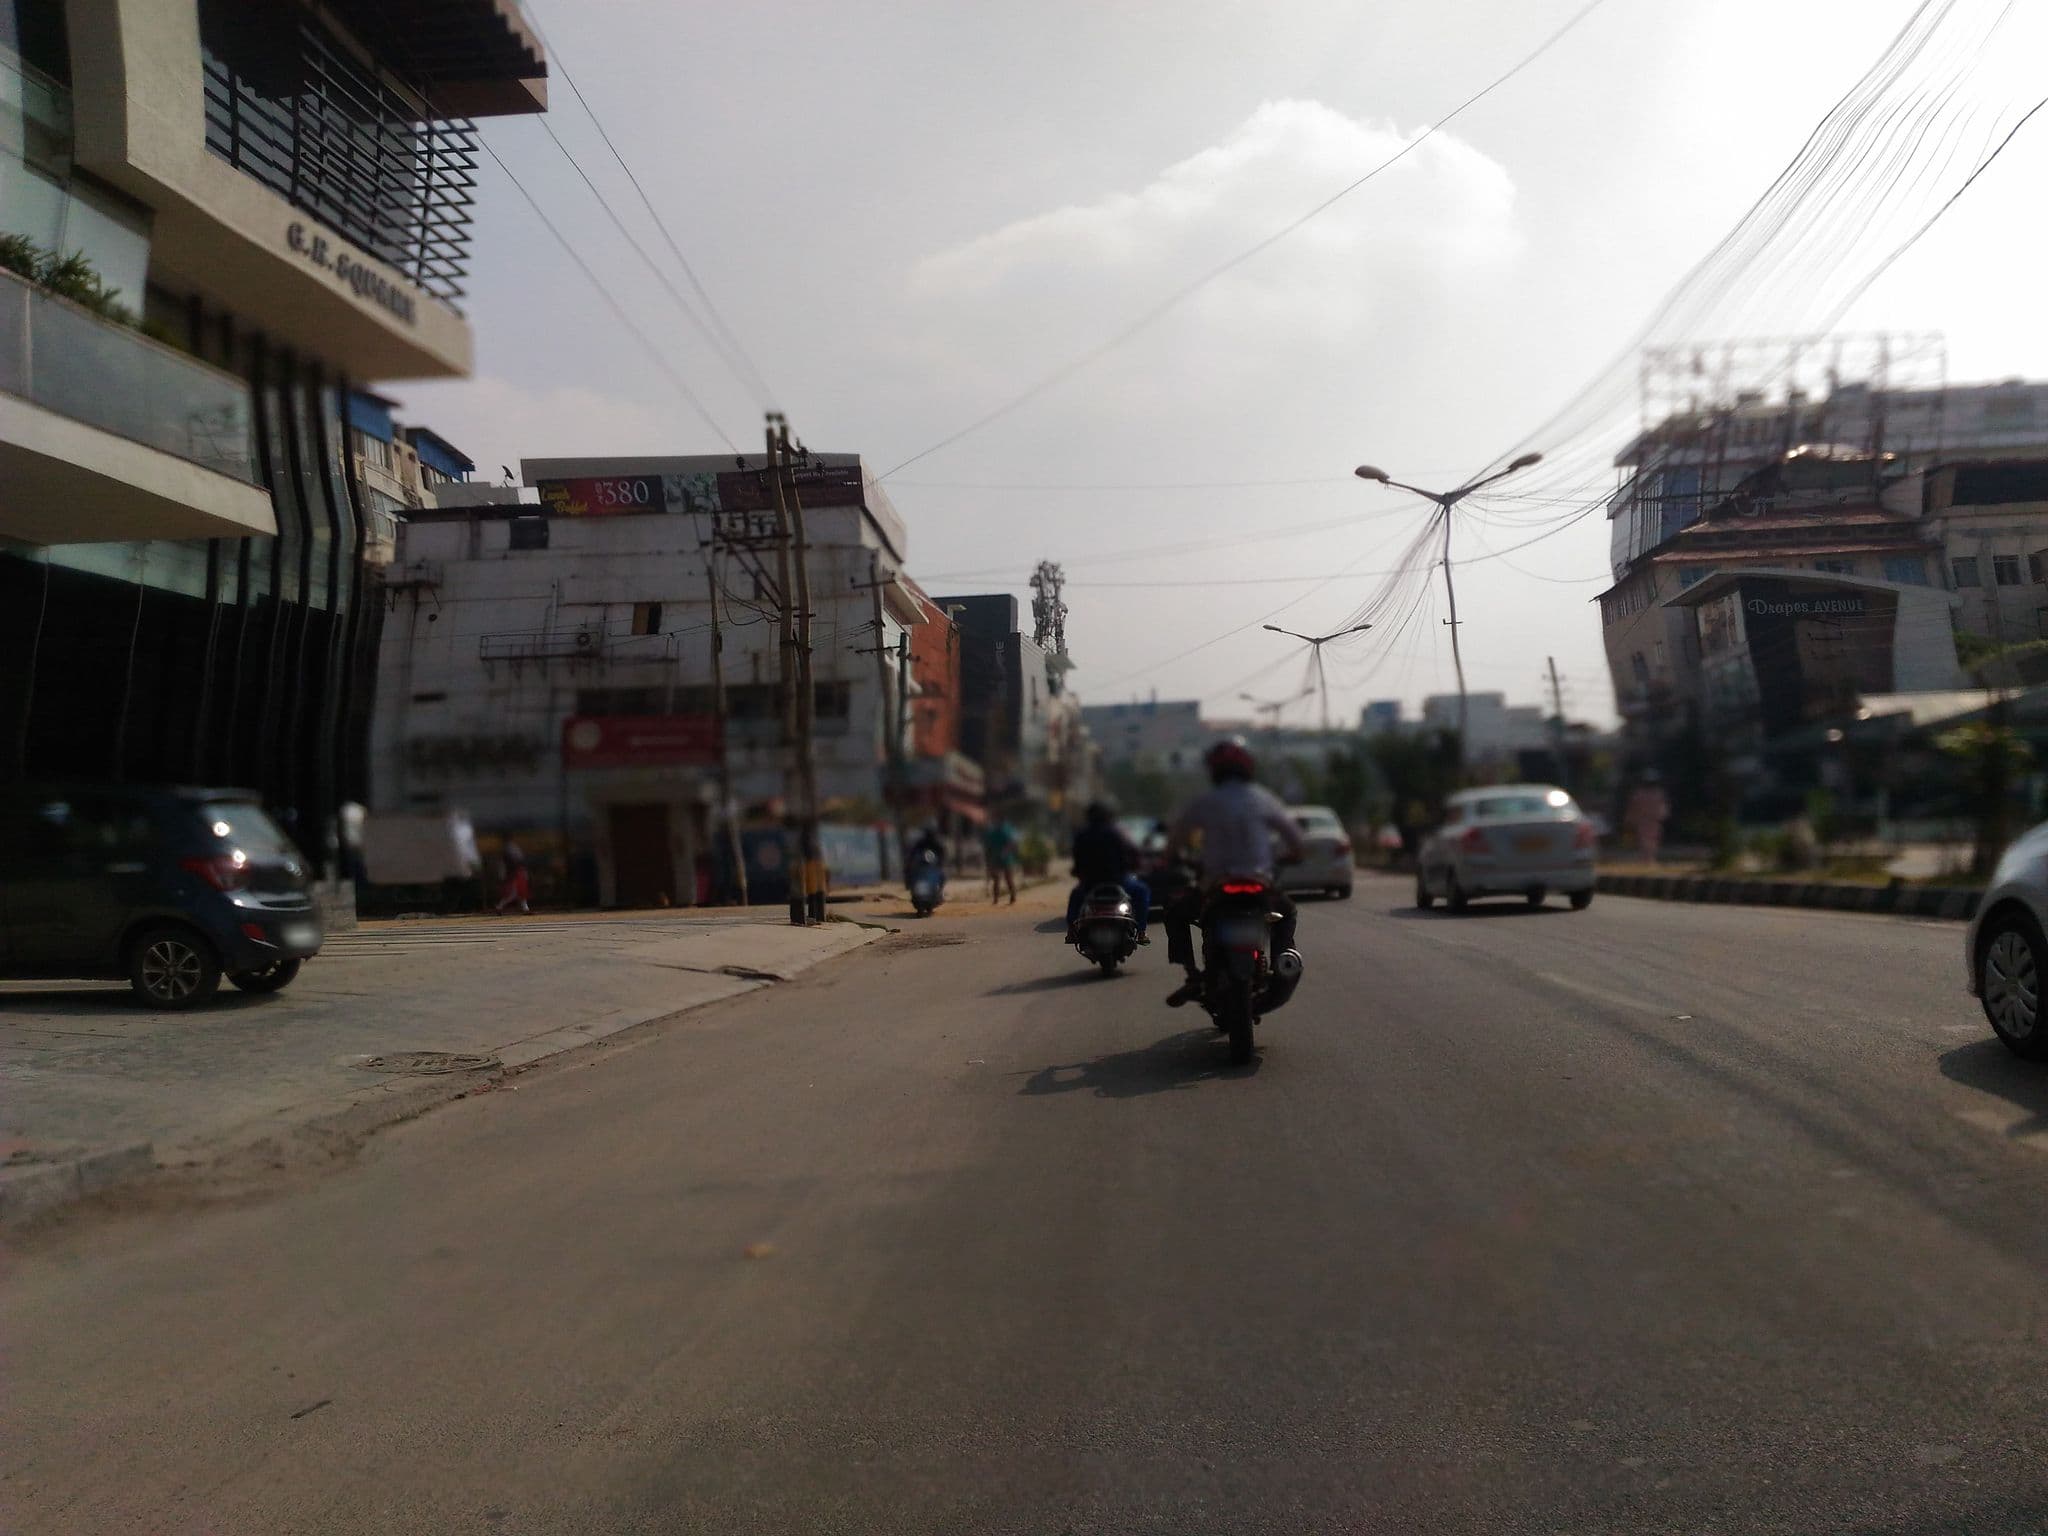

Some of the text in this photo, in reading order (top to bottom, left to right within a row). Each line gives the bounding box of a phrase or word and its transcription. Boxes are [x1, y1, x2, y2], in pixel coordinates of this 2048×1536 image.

[603, 480, 649, 505] 380
[1748, 599, 1864, 616] Drapes AVENUE
